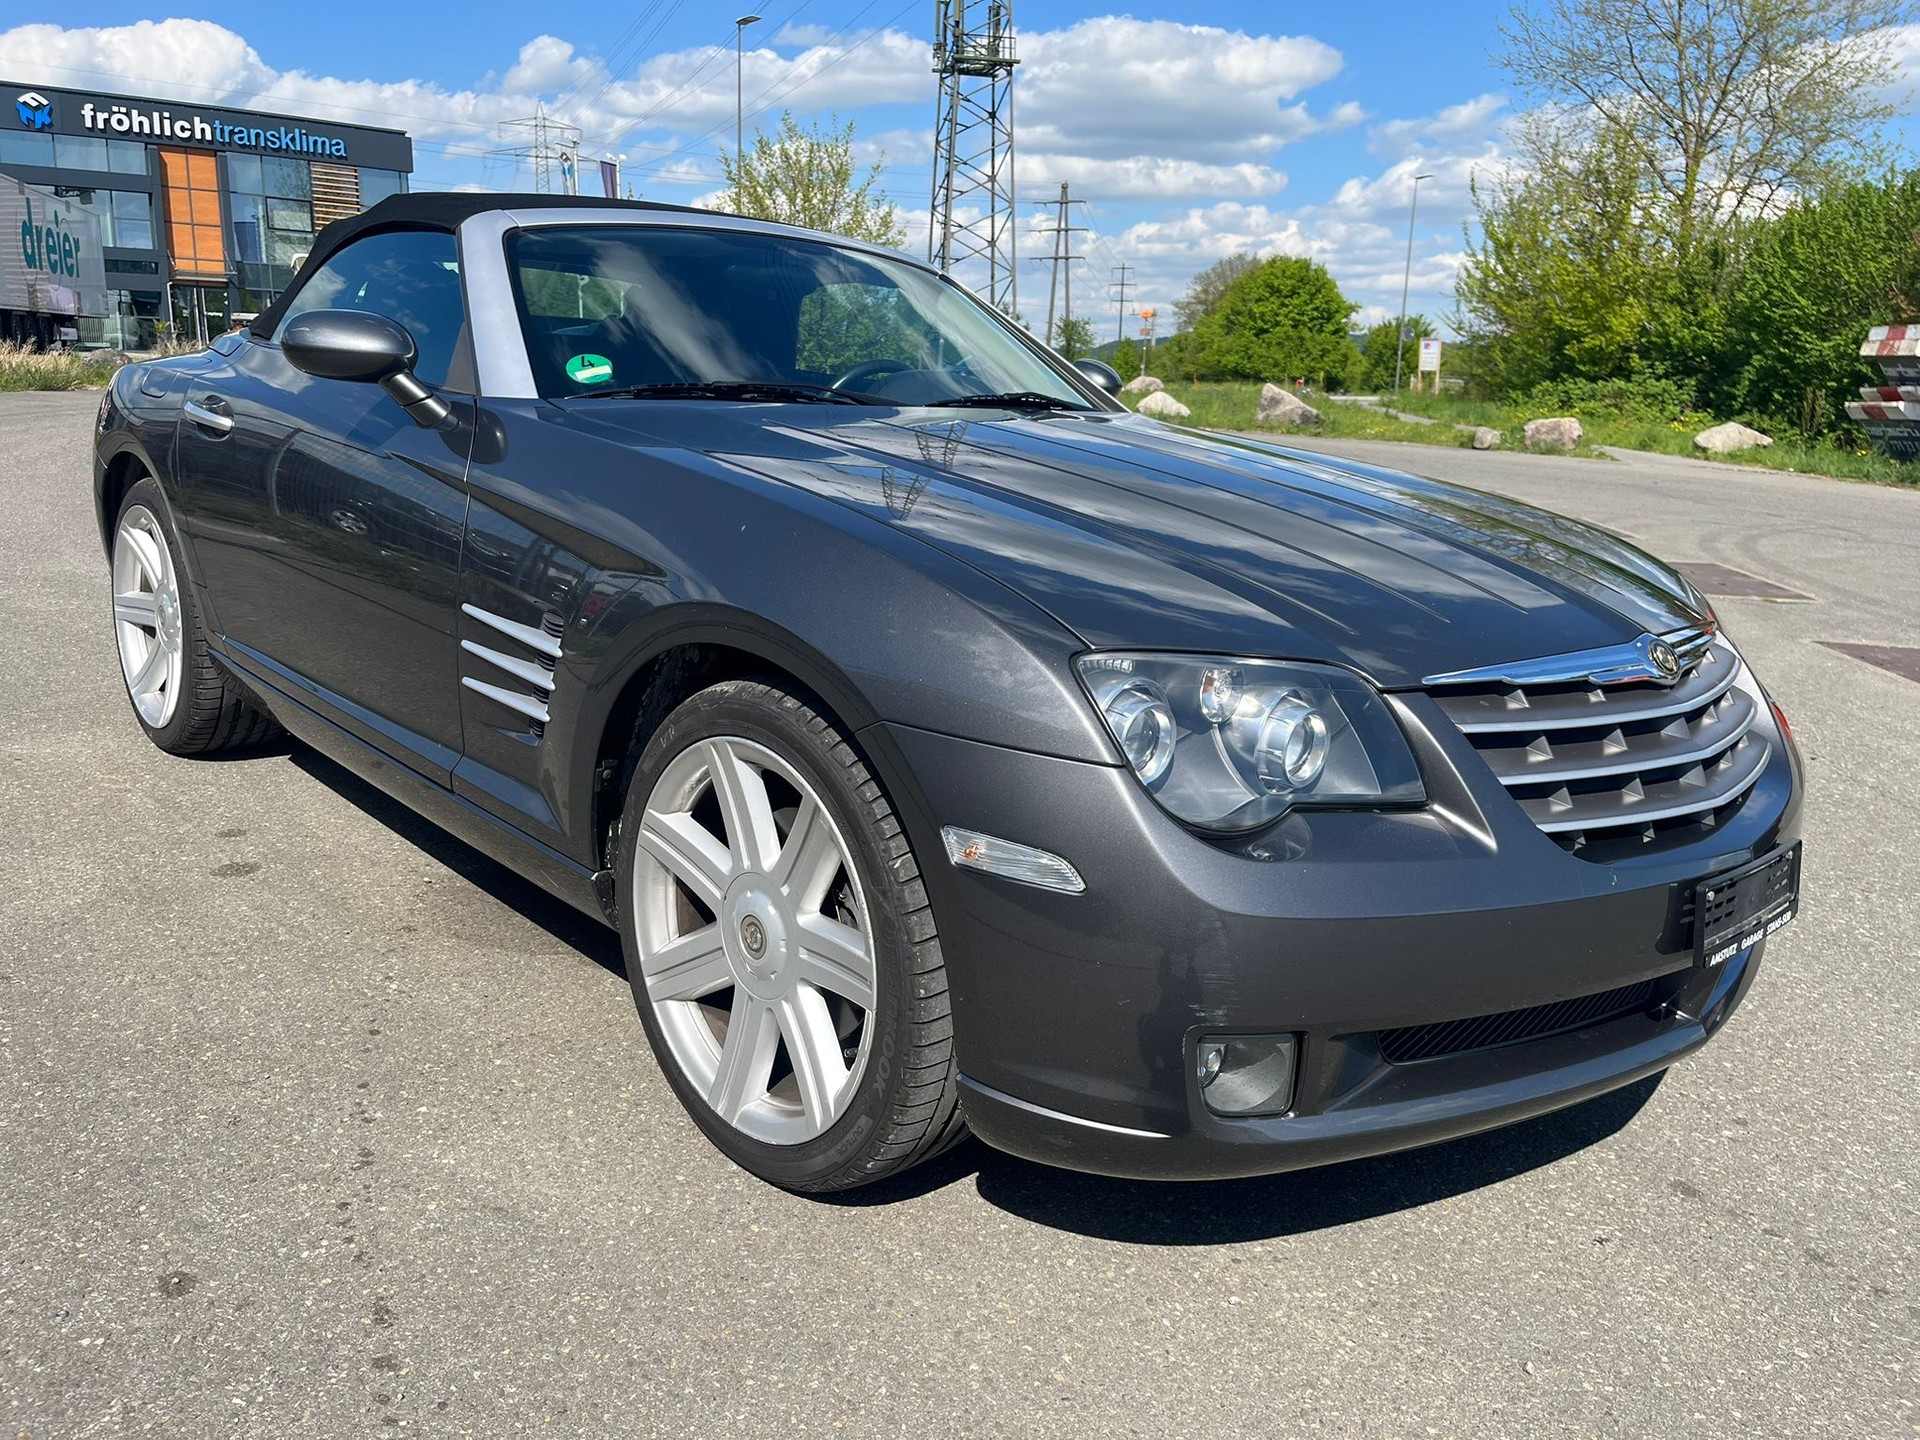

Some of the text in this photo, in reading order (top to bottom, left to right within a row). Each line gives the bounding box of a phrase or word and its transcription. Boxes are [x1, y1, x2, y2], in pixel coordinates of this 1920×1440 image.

[21, 197, 80, 278] dreier
[581, 355, 594, 368] 4
[1710, 943, 1738, 967] AMSTUTZ
[1741, 929, 1764, 950] GARAGE
